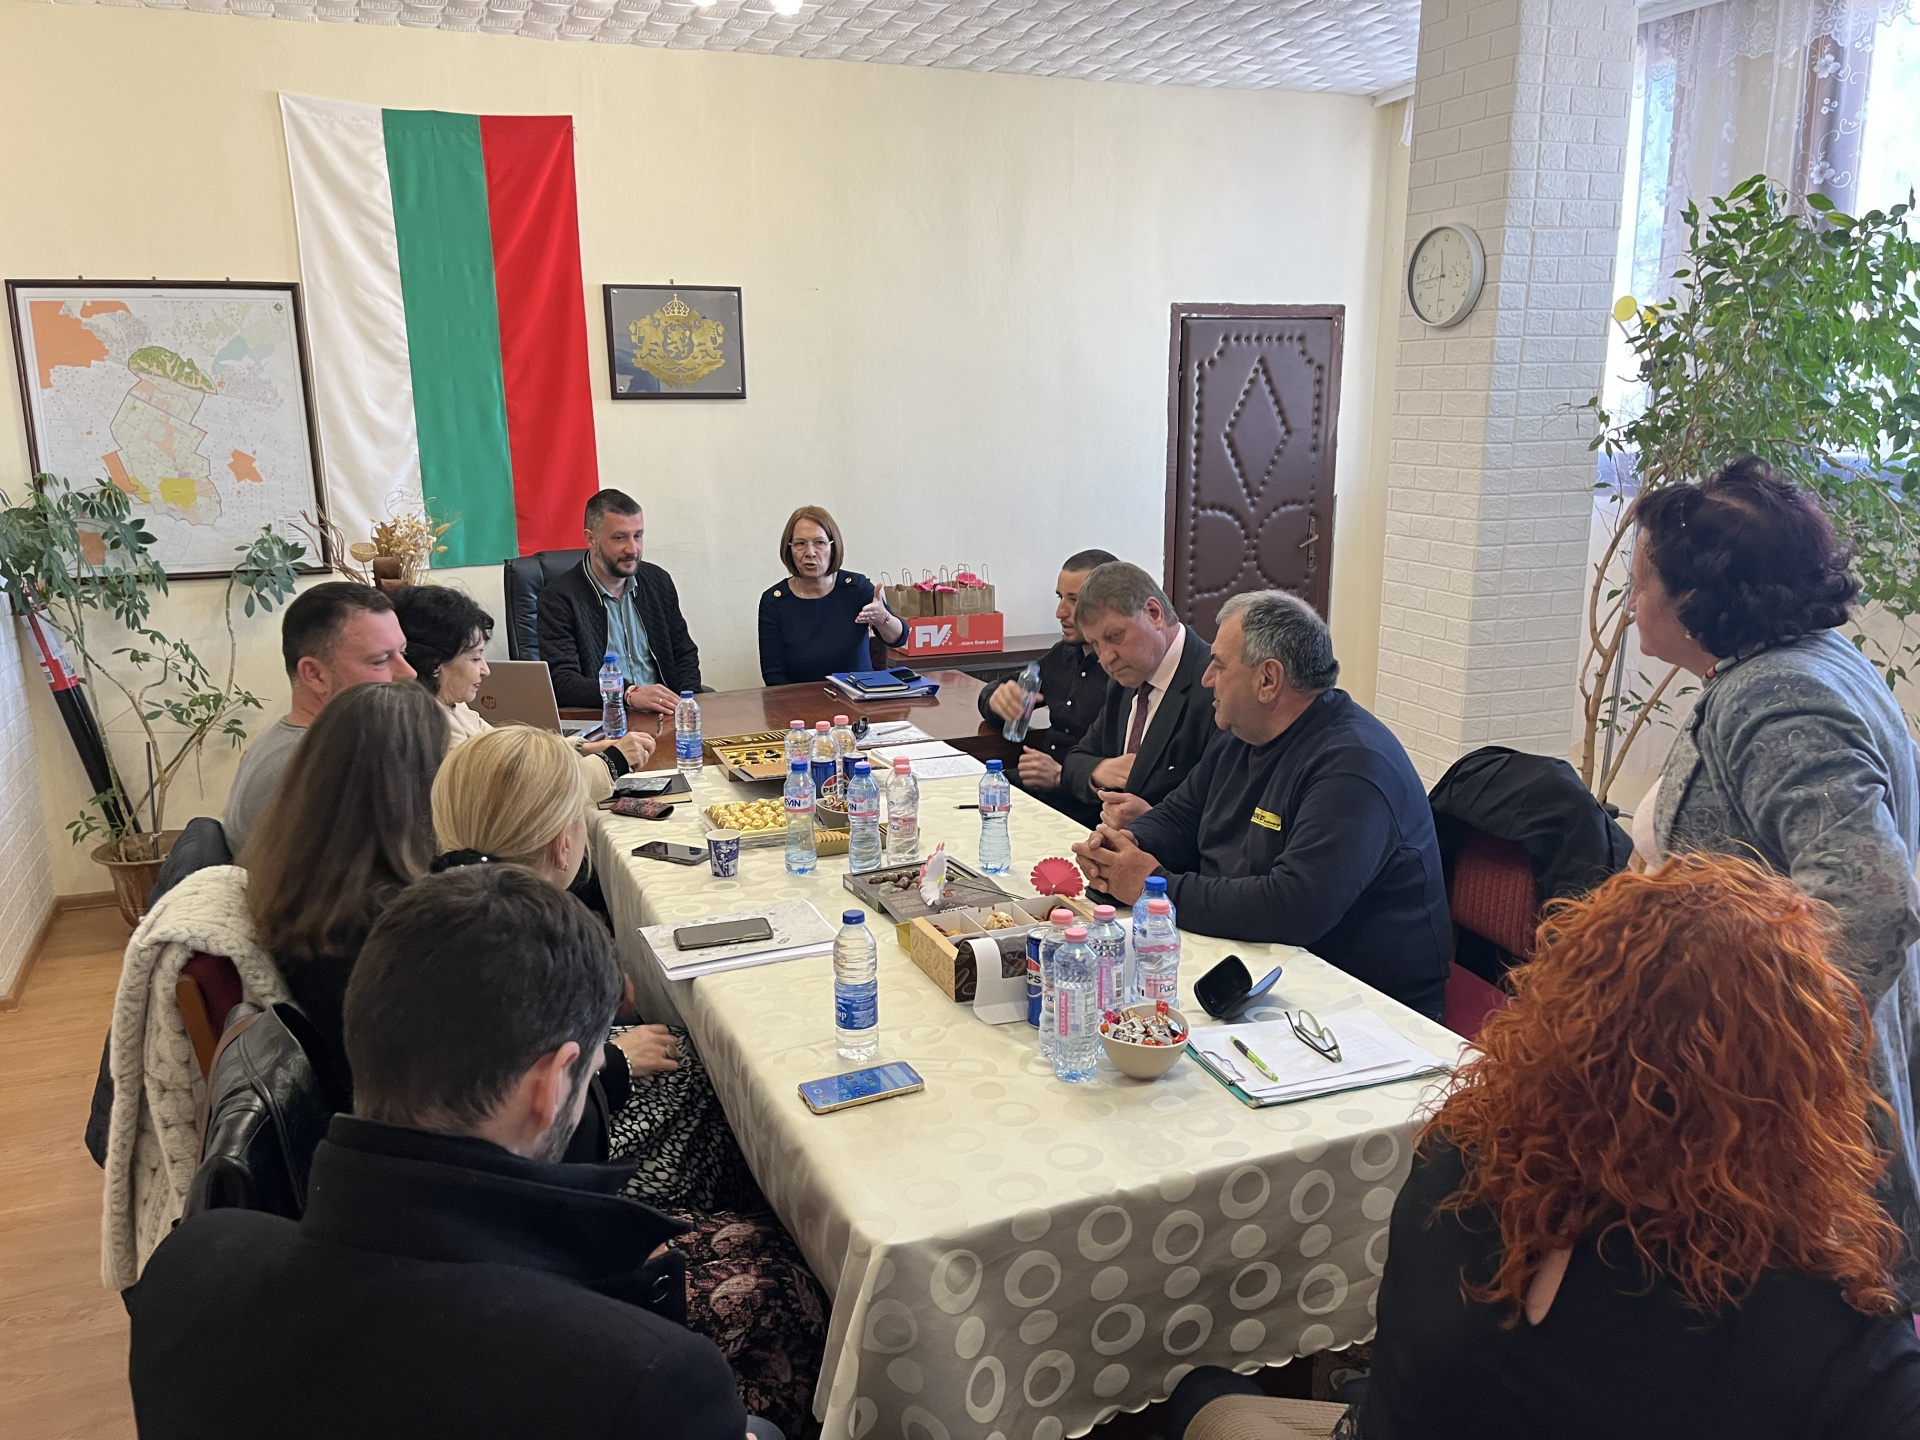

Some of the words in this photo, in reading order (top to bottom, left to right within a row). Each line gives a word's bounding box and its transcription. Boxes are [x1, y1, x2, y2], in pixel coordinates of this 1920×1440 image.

[1444, 233, 1450, 242] 12
[1466, 250, 1471, 259] 2
[1421, 255, 1428, 264] 10
[1461, 289, 1467, 298] 4
[1426, 305, 1432, 313] 7
[1451, 304, 1456, 313] 5
[1438, 310, 1443, 318] 6
[915, 623, 952, 648] FV
[941, 629, 953, 646] PLAST
[482, 695, 496, 710] hp
[1027, 973, 1042, 984] PS
